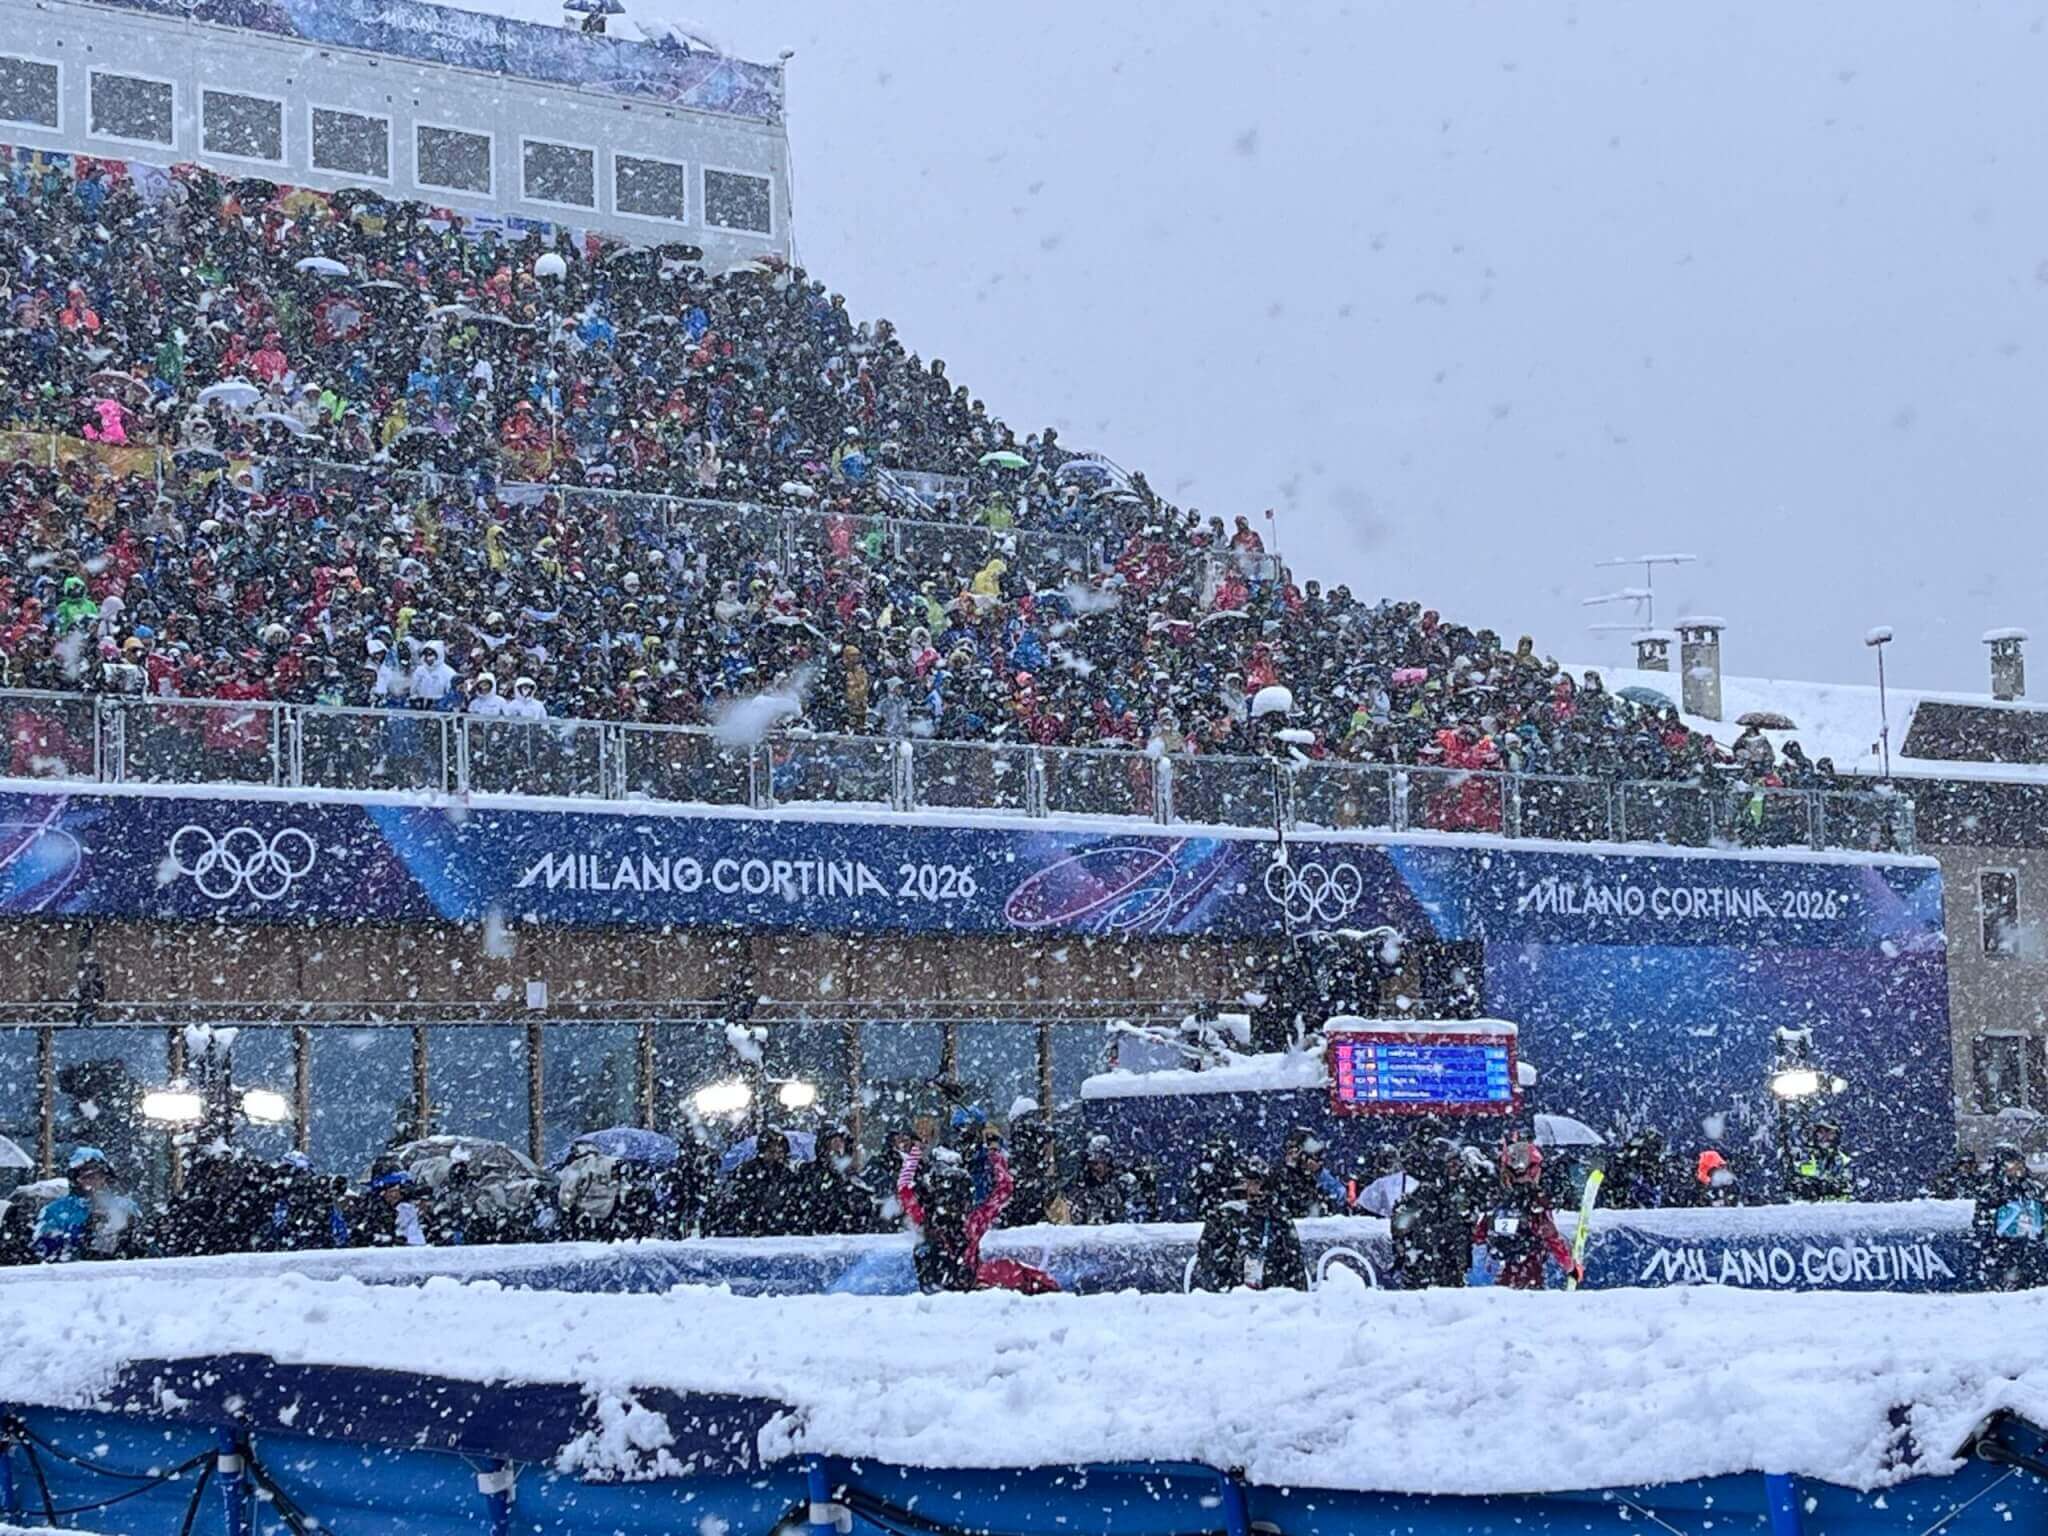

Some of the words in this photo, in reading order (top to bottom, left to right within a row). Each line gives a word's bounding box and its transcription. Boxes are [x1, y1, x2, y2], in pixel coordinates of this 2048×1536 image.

[431, 35, 464, 51] 2026
[513, 852, 701, 893] MILANO
[712, 859, 889, 896] CORTINA
[900, 864, 977, 899] 2026
[1518, 883, 1645, 916] MILANO
[1652, 887, 1776, 918] CORTINA
[1782, 890, 1837, 919] 2026
[1640, 1247, 1795, 1284] MILANO
[1801, 1246, 1955, 1284] CORTINA
